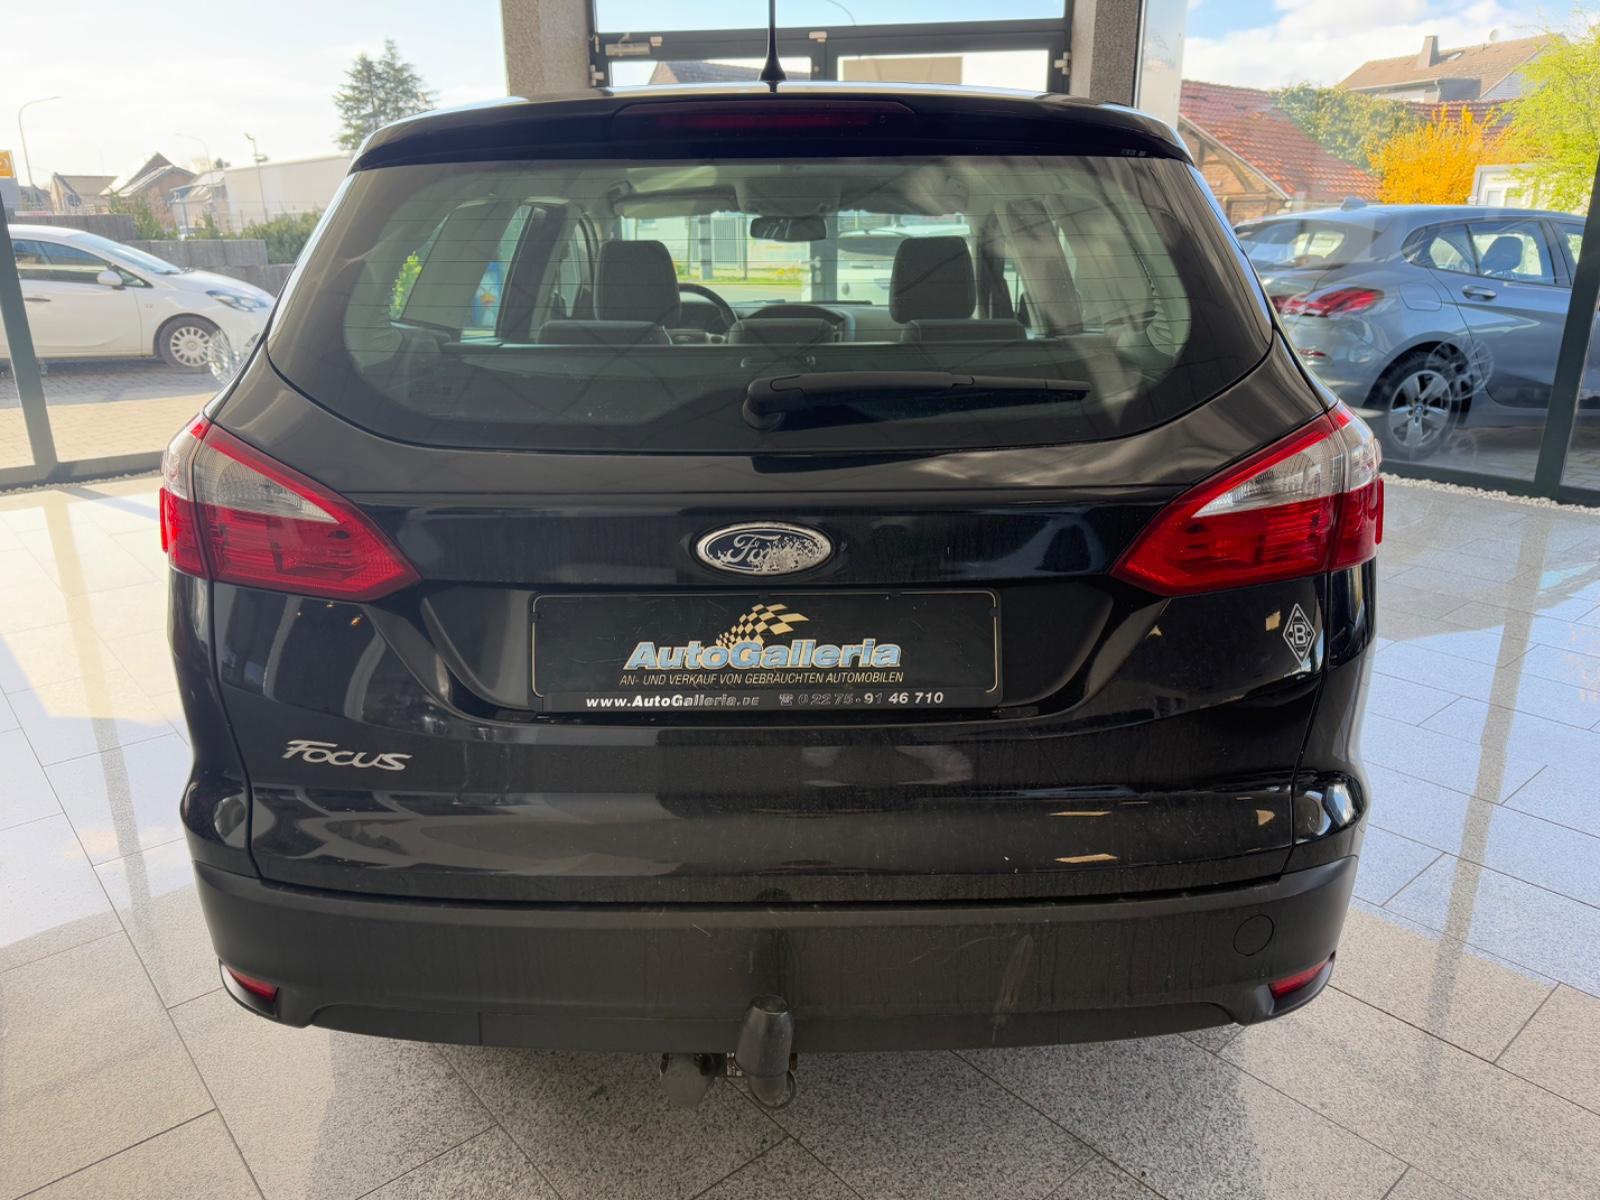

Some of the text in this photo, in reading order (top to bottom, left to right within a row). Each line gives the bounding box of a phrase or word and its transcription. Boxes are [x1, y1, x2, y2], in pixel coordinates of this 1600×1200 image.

[1294, 624, 1307, 645] B
[623, 638, 901, 670] AutoGalleria
[619, 671, 904, 686] AN- UND VERKAUF VON GEBRAUCHTEN AUTOMOBILEN
[888, 692, 909, 704] 46
[914, 691, 945, 704] 710
